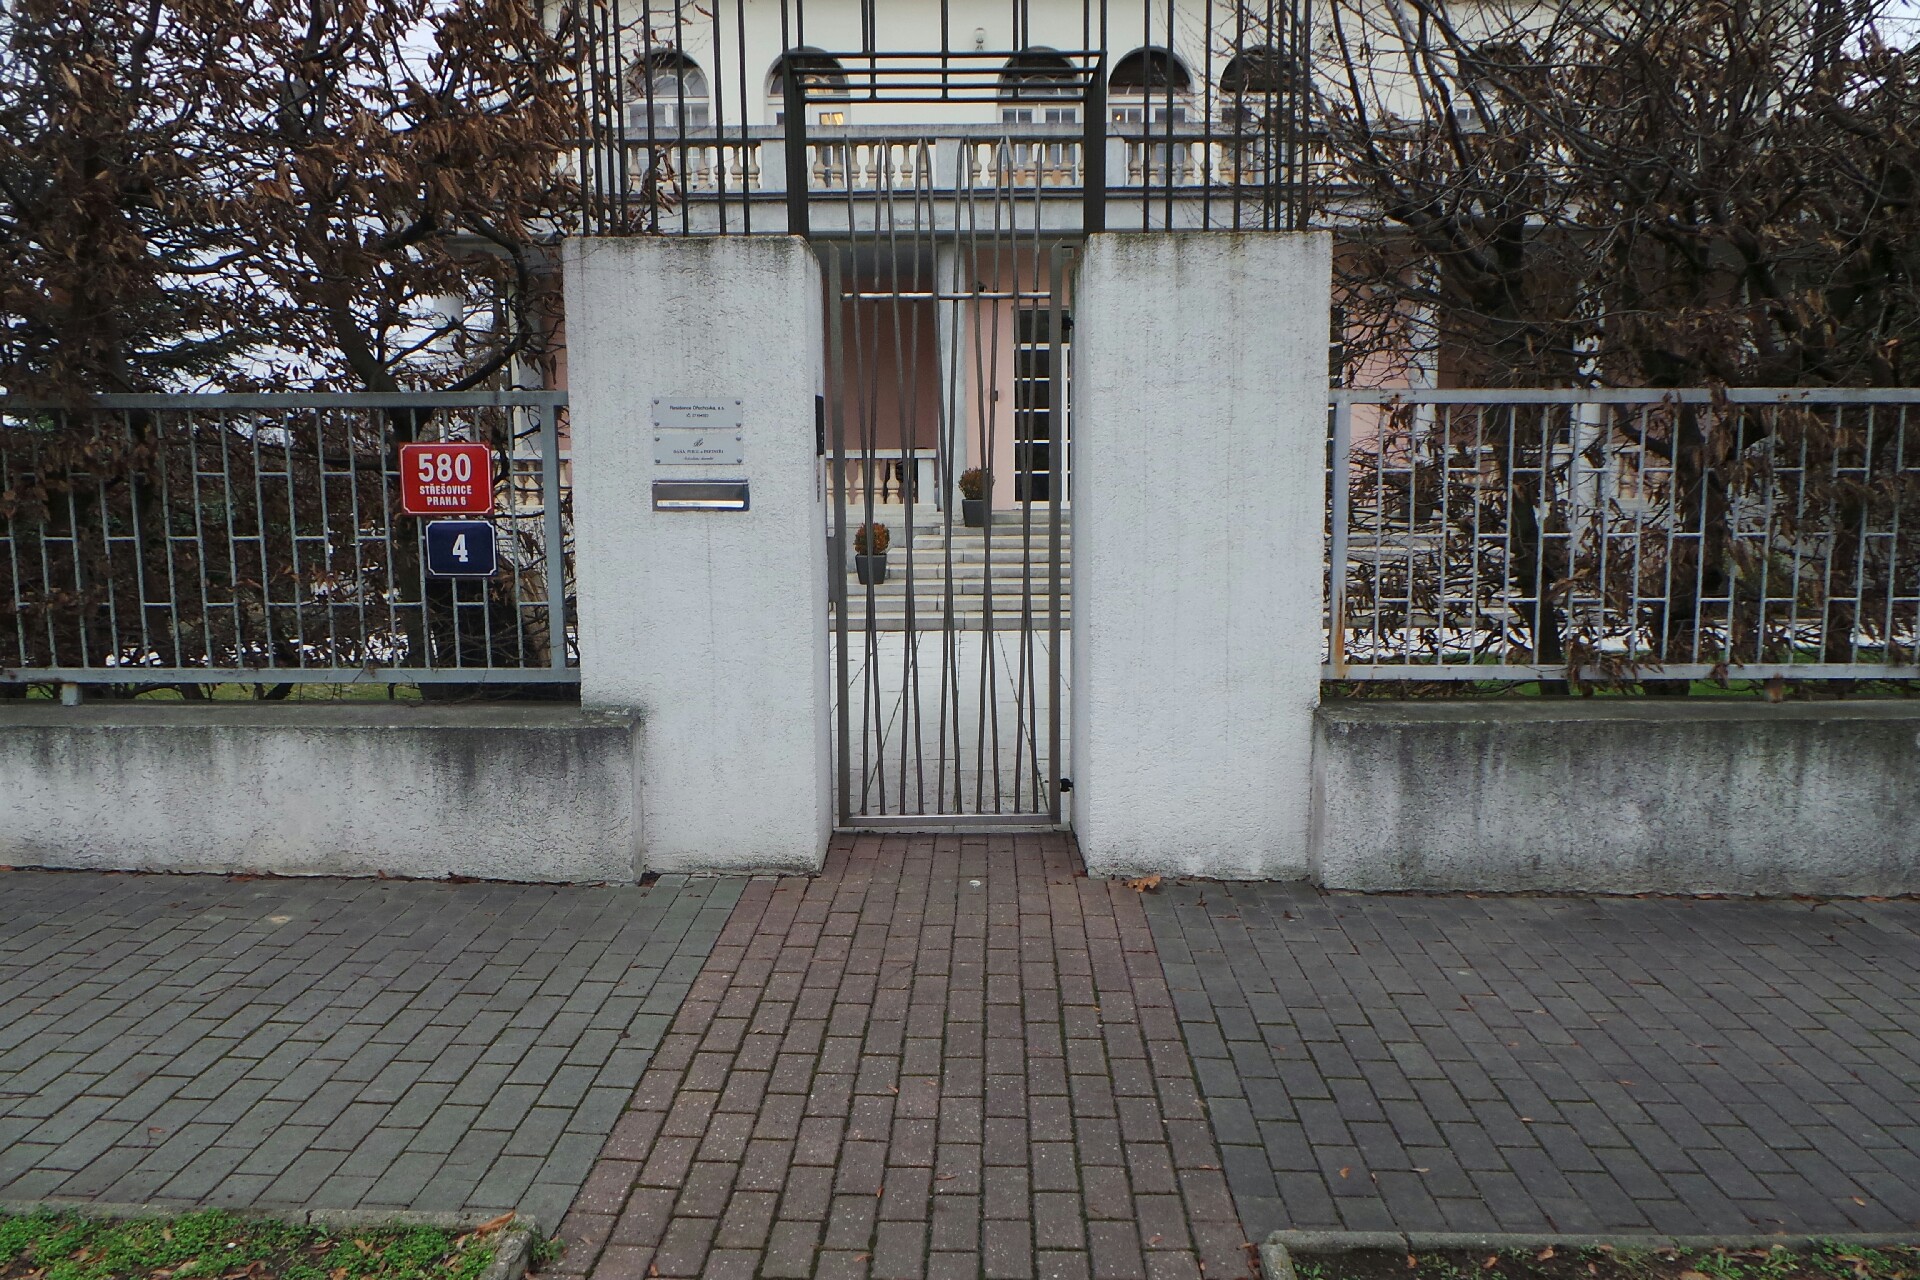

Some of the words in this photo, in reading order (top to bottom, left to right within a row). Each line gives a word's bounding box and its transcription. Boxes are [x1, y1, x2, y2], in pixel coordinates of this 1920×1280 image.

[418, 453, 471, 482] 580
[420, 484, 472, 495] STŘEŠOVICE
[426, 496, 459, 506] PRAHA
[460, 496, 467, 506] 6
[452, 534, 469, 562] 4
